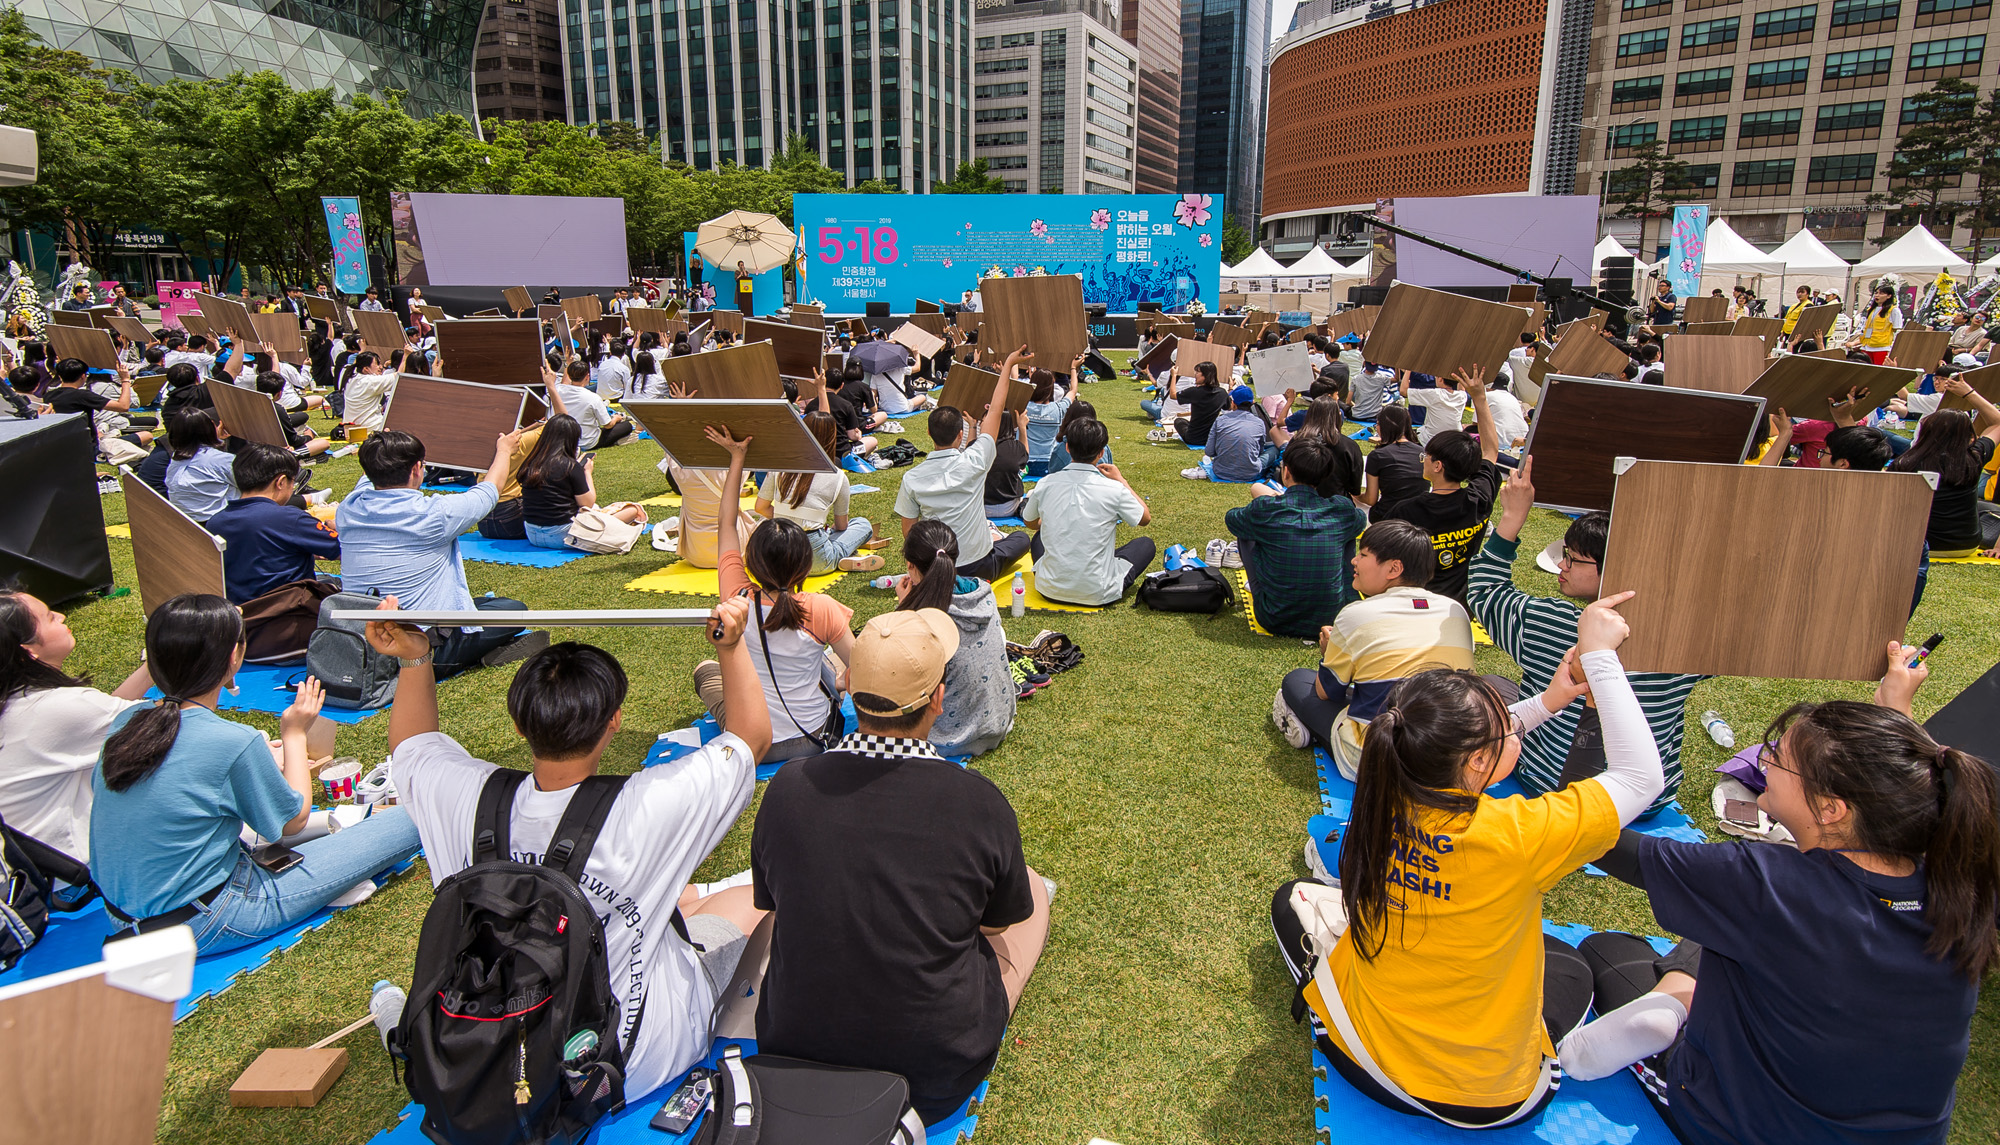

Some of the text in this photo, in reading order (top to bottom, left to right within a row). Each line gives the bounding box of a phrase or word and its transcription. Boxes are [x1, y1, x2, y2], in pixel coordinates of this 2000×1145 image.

[1116, 210, 1149, 222] 오늘을
[1116, 223, 1176, 237] 밝히는 오월,
[115, 233, 165, 244] 서울특별시청
[1116, 237, 1152, 250] 진실로!
[1116, 250, 1152, 264] 평화로!
[842, 266, 876, 276] 민중항쟁
[832, 277, 887, 288] 제39주년기념
[843, 288, 877, 299] 서울행사
[615, 896, 642, 929] 2019
